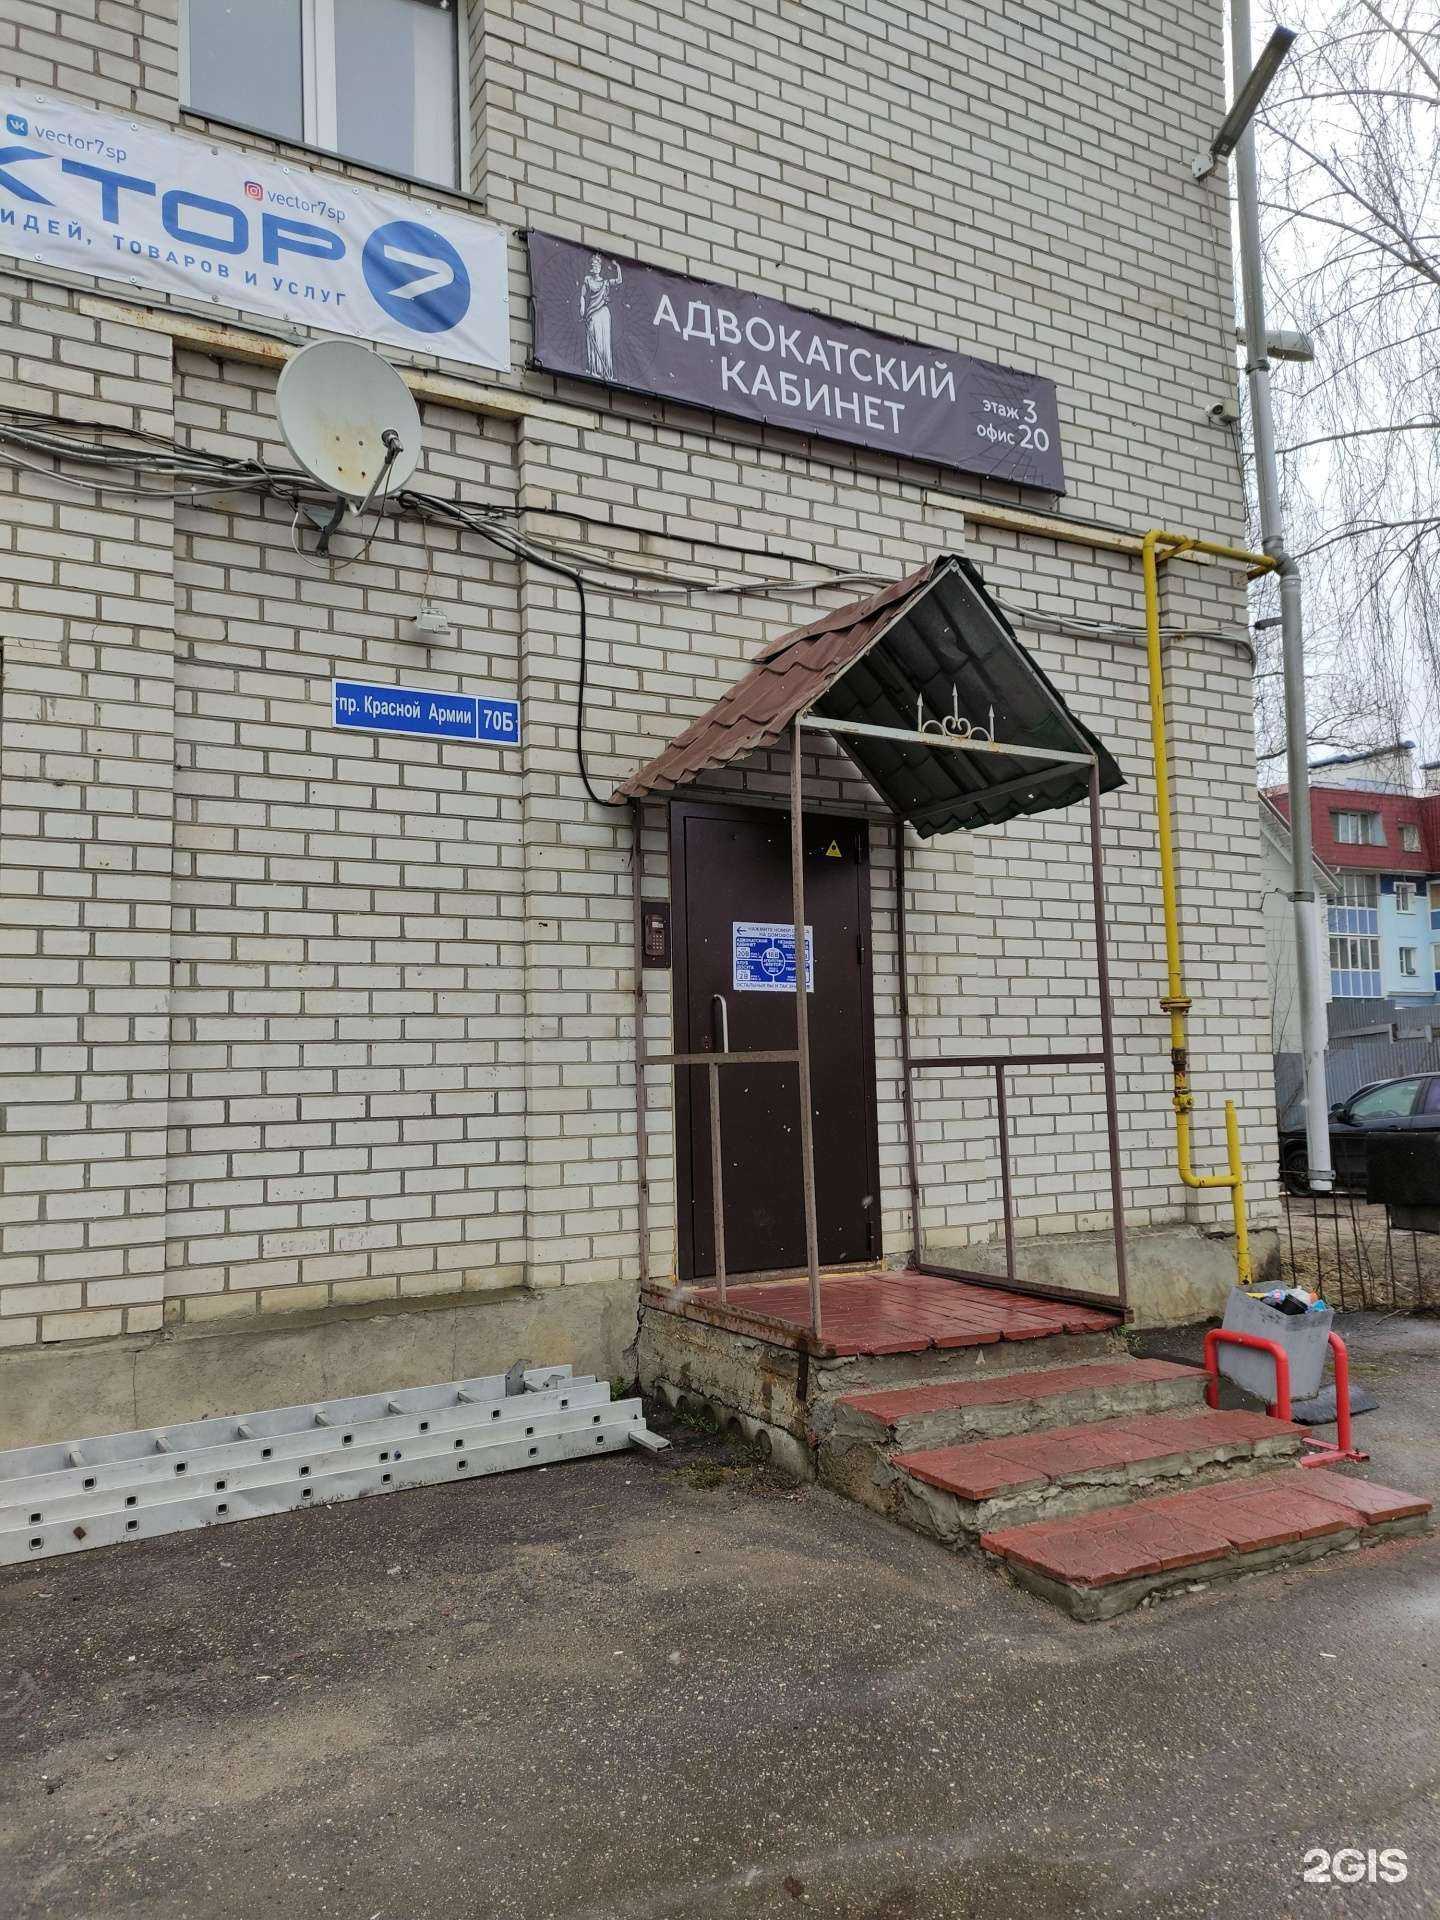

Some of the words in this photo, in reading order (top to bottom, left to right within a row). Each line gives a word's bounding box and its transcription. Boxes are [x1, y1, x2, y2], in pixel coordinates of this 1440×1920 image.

[34, 125, 127, 163] vector7sp
[267, 190, 346, 223] vector7sp
[112, 233, 230, 278] ТОВАРОВ
[245, 270, 257, 286] И
[272, 276, 347, 306] УСЛУГ
[652, 293, 956, 402] АДВОКАТСКИЙ
[721, 355, 906, 434] КАБИНЕТ
[982, 399, 1020, 420] этаж
[1022, 399, 1038, 424] 3
[976, 422, 1016, 445] офис
[1017, 424, 1050, 452] 20
[340, 697, 360, 715] пр.
[364, 695, 421, 718] Красной
[428, 703, 472, 725] Армии
[483, 709, 514, 732] 70Б
